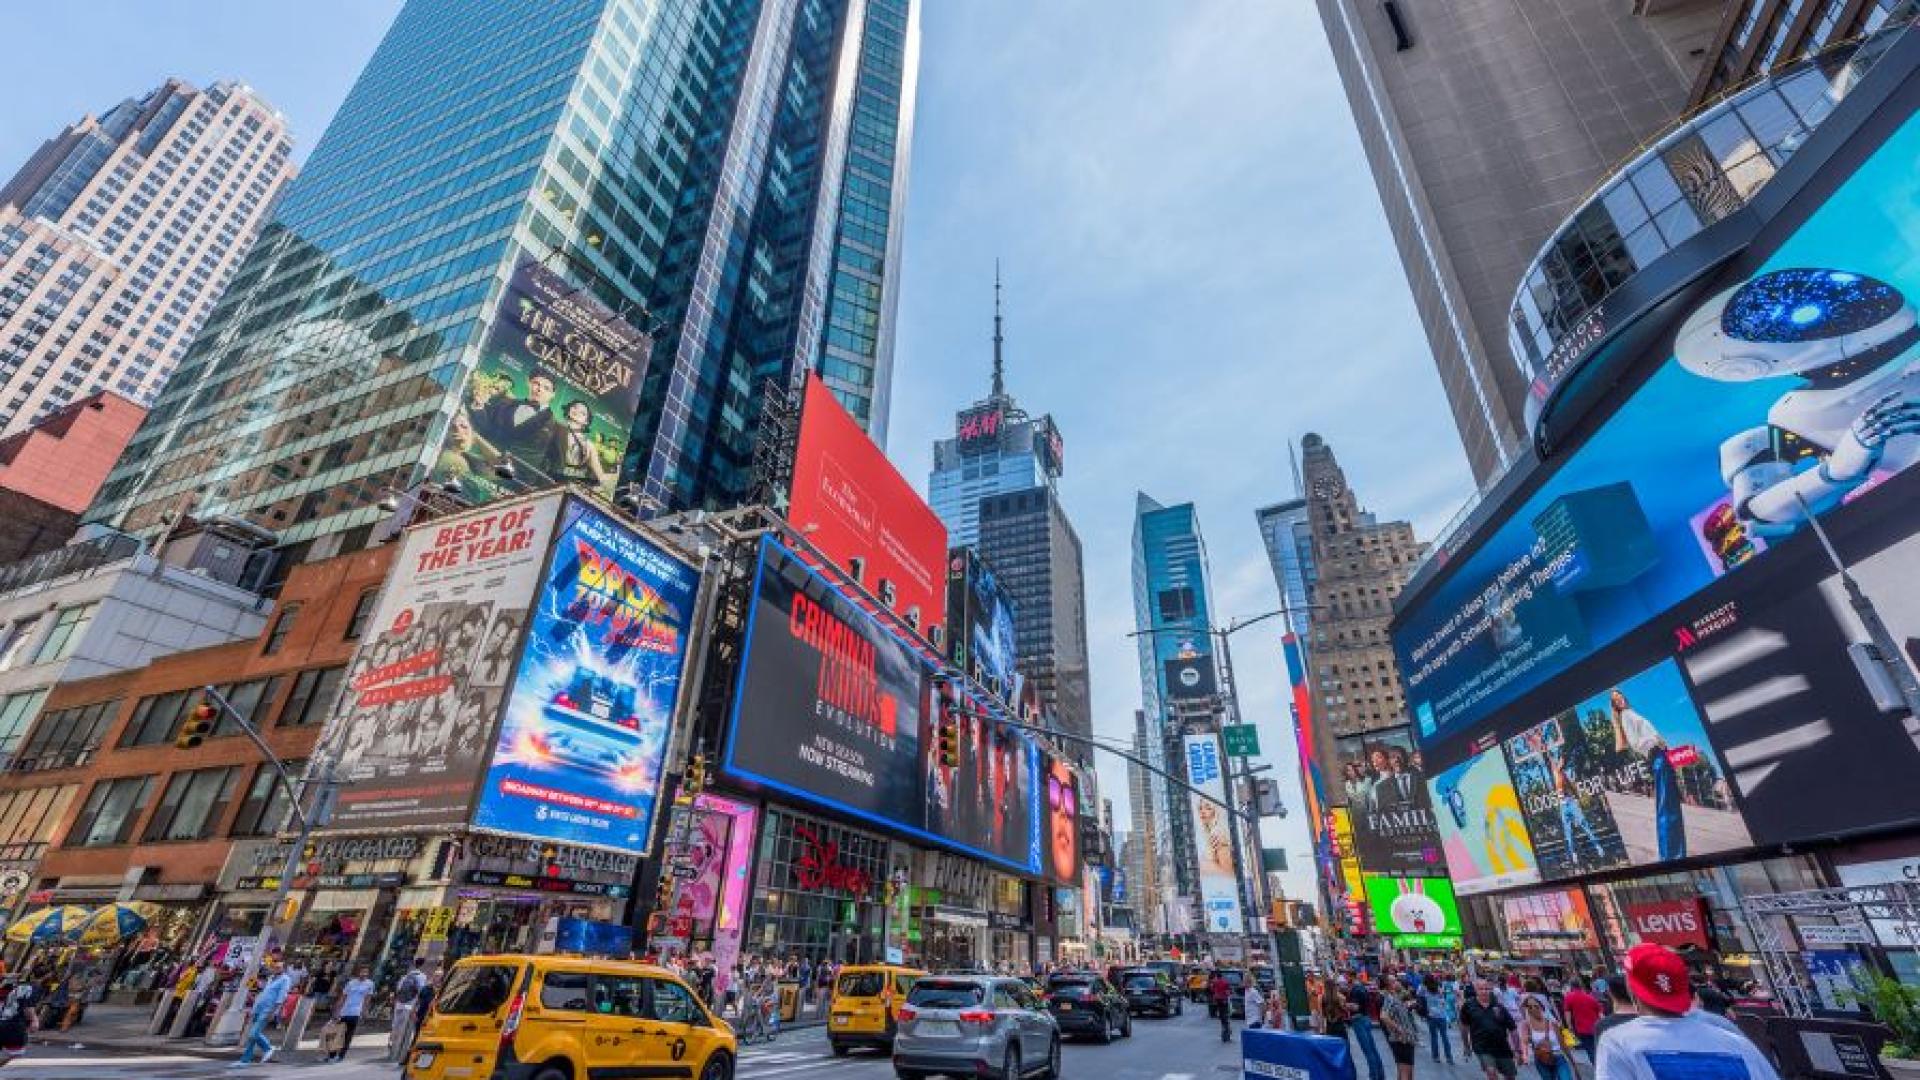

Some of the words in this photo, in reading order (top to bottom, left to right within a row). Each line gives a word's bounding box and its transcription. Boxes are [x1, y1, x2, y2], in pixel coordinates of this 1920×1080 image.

[435, 516, 497, 548] BEST
[500, 506, 534, 532] OF
[417, 546, 462, 573] THE
[466, 528, 535, 562] YEAR!
[789, 590, 876, 671] CRIMINAL
[815, 700, 897, 752] EVOLUTION
[799, 744, 824, 764] NOW
[825, 754, 875, 788] STREAMING
[815, 734, 834, 753] NEW
[835, 744, 866, 767] SEASON
[1576, 775, 1604, 794] FOR
[1614, 760, 1648, 786] LIFE
